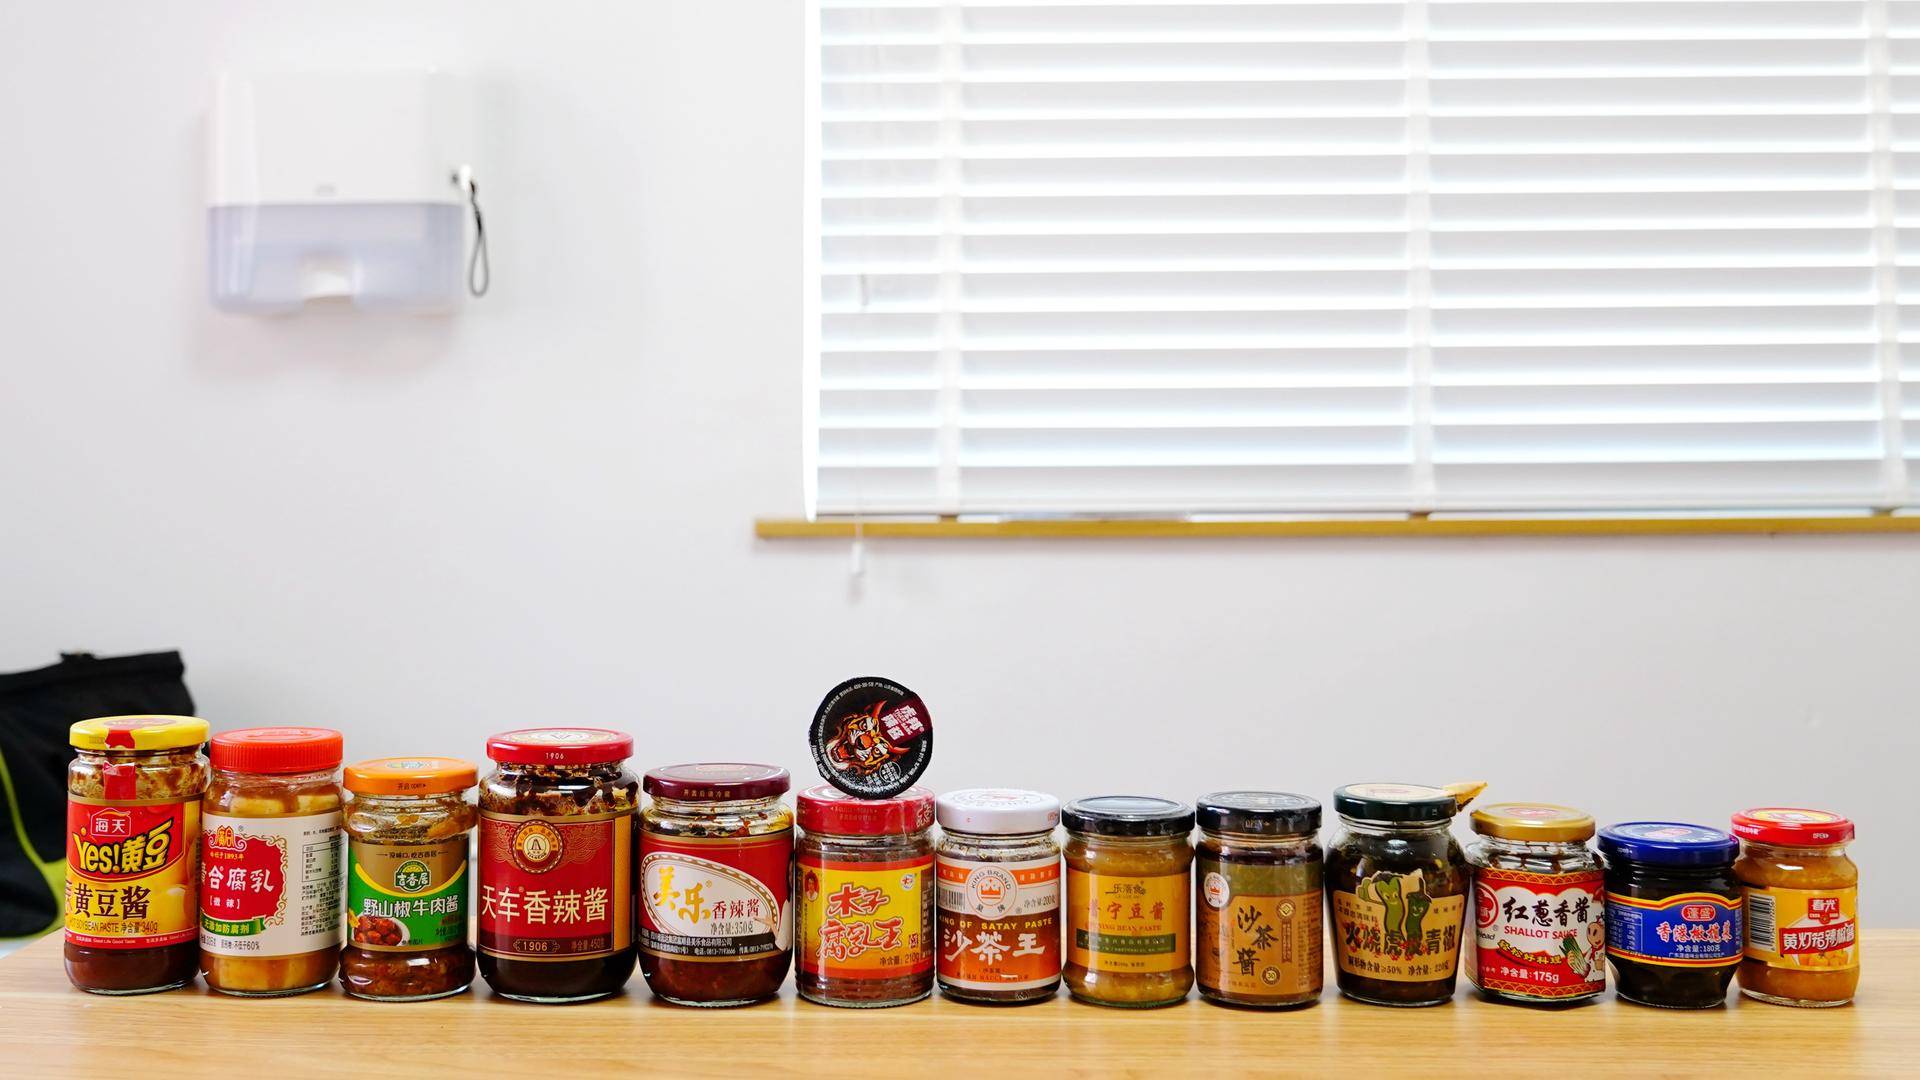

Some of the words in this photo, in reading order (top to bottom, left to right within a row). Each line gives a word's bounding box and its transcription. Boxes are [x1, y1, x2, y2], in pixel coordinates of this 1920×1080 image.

[545, 752, 565, 760] 1906
[95, 817, 126, 834] 海天
[970, 871, 986, 889] KING
[987, 869, 1012, 890] BRAND
[74, 882, 151, 920] 黄豆酱
[363, 895, 458, 918] 野山椒牛肉酱
[482, 885, 609, 924] 天车香辣酱
[712, 899, 760, 920] 香辣酱
[100, 921, 120, 933] PASTE
[960, 920, 973, 928] OF
[981, 922, 1018, 930] SATAY
[1024, 917, 1052, 928] PASTE
[1504, 925, 1549, 939] SHALLOT
[1552, 928, 1578, 940] SAUCE
[523, 941, 548, 951] 1906
[943, 928, 1046, 966] 沙茶王
